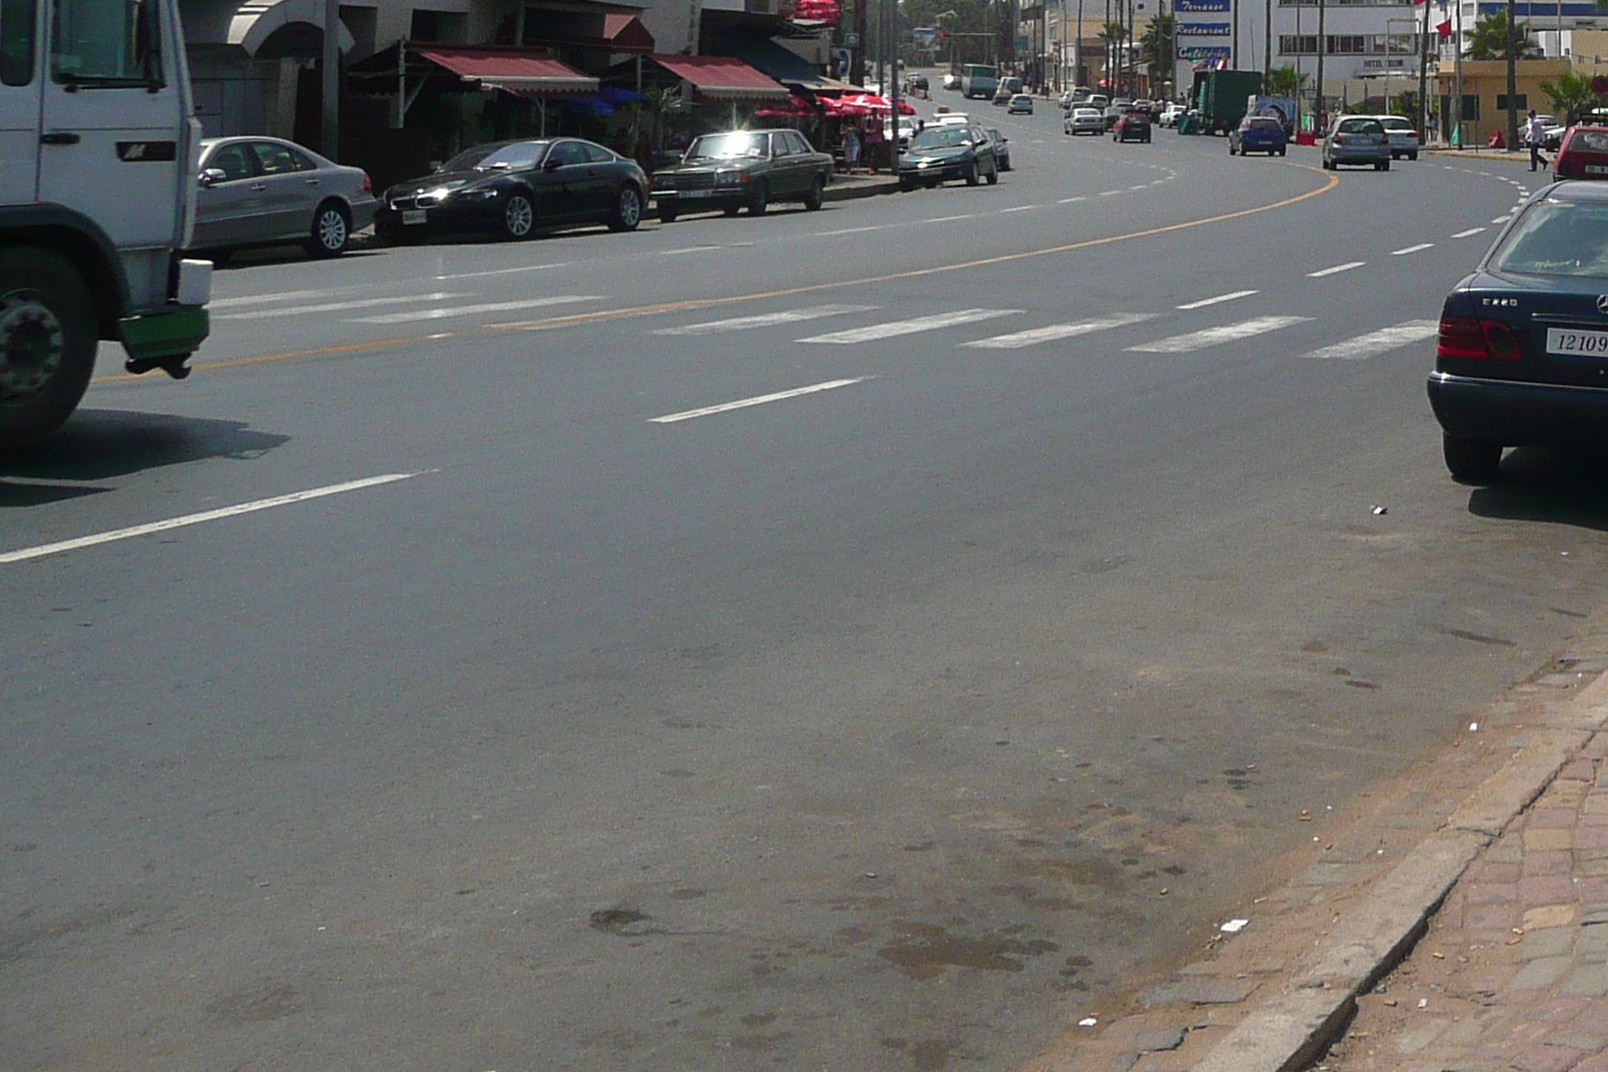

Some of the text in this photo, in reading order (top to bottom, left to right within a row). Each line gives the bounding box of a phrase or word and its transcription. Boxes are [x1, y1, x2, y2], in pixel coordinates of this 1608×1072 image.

[1181, 1, 1224, 11] Terrasse
[1176, 25, 1230, 35] Restaurant
[1558, 334, 1608, 353] 12109
